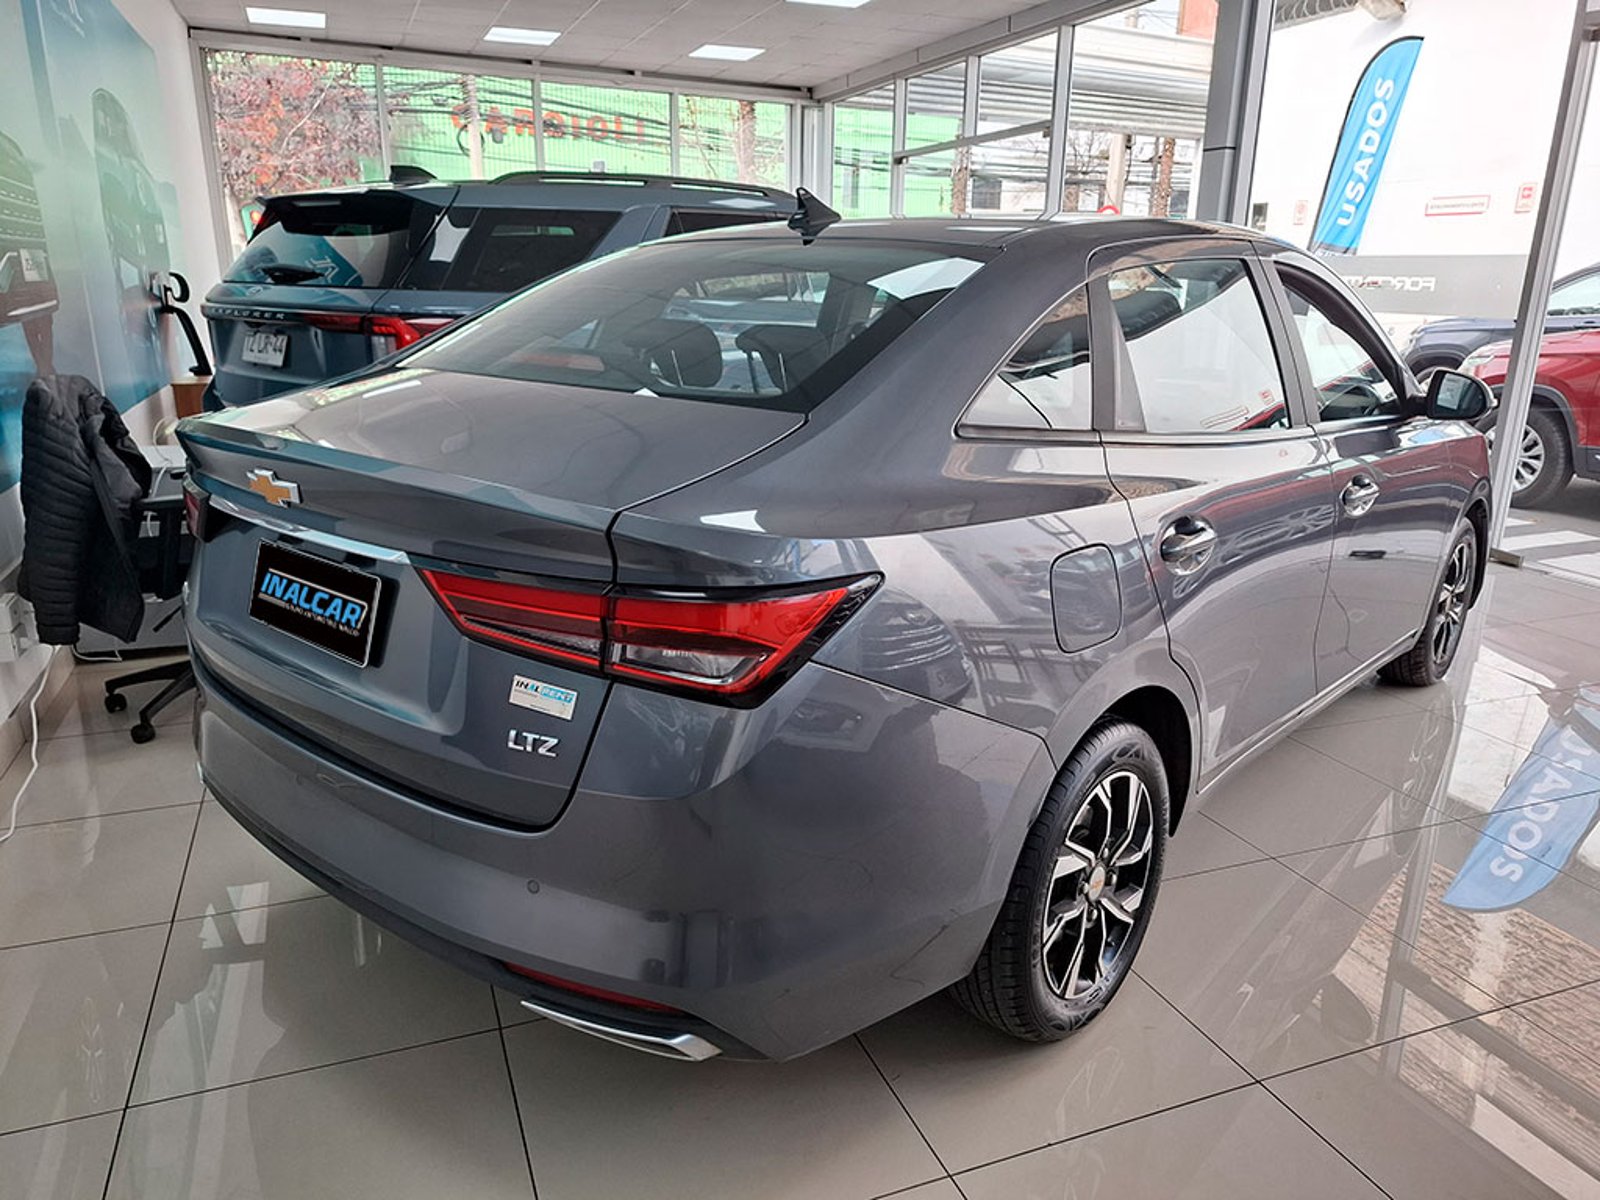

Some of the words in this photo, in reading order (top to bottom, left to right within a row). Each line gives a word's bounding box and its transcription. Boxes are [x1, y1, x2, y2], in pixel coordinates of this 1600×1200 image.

[1336, 77, 1395, 227] USADOS
[211, 307, 286, 320] EXPLORER
[260, 572, 362, 628] INALCAR
[507, 728, 560, 758] LTZ
